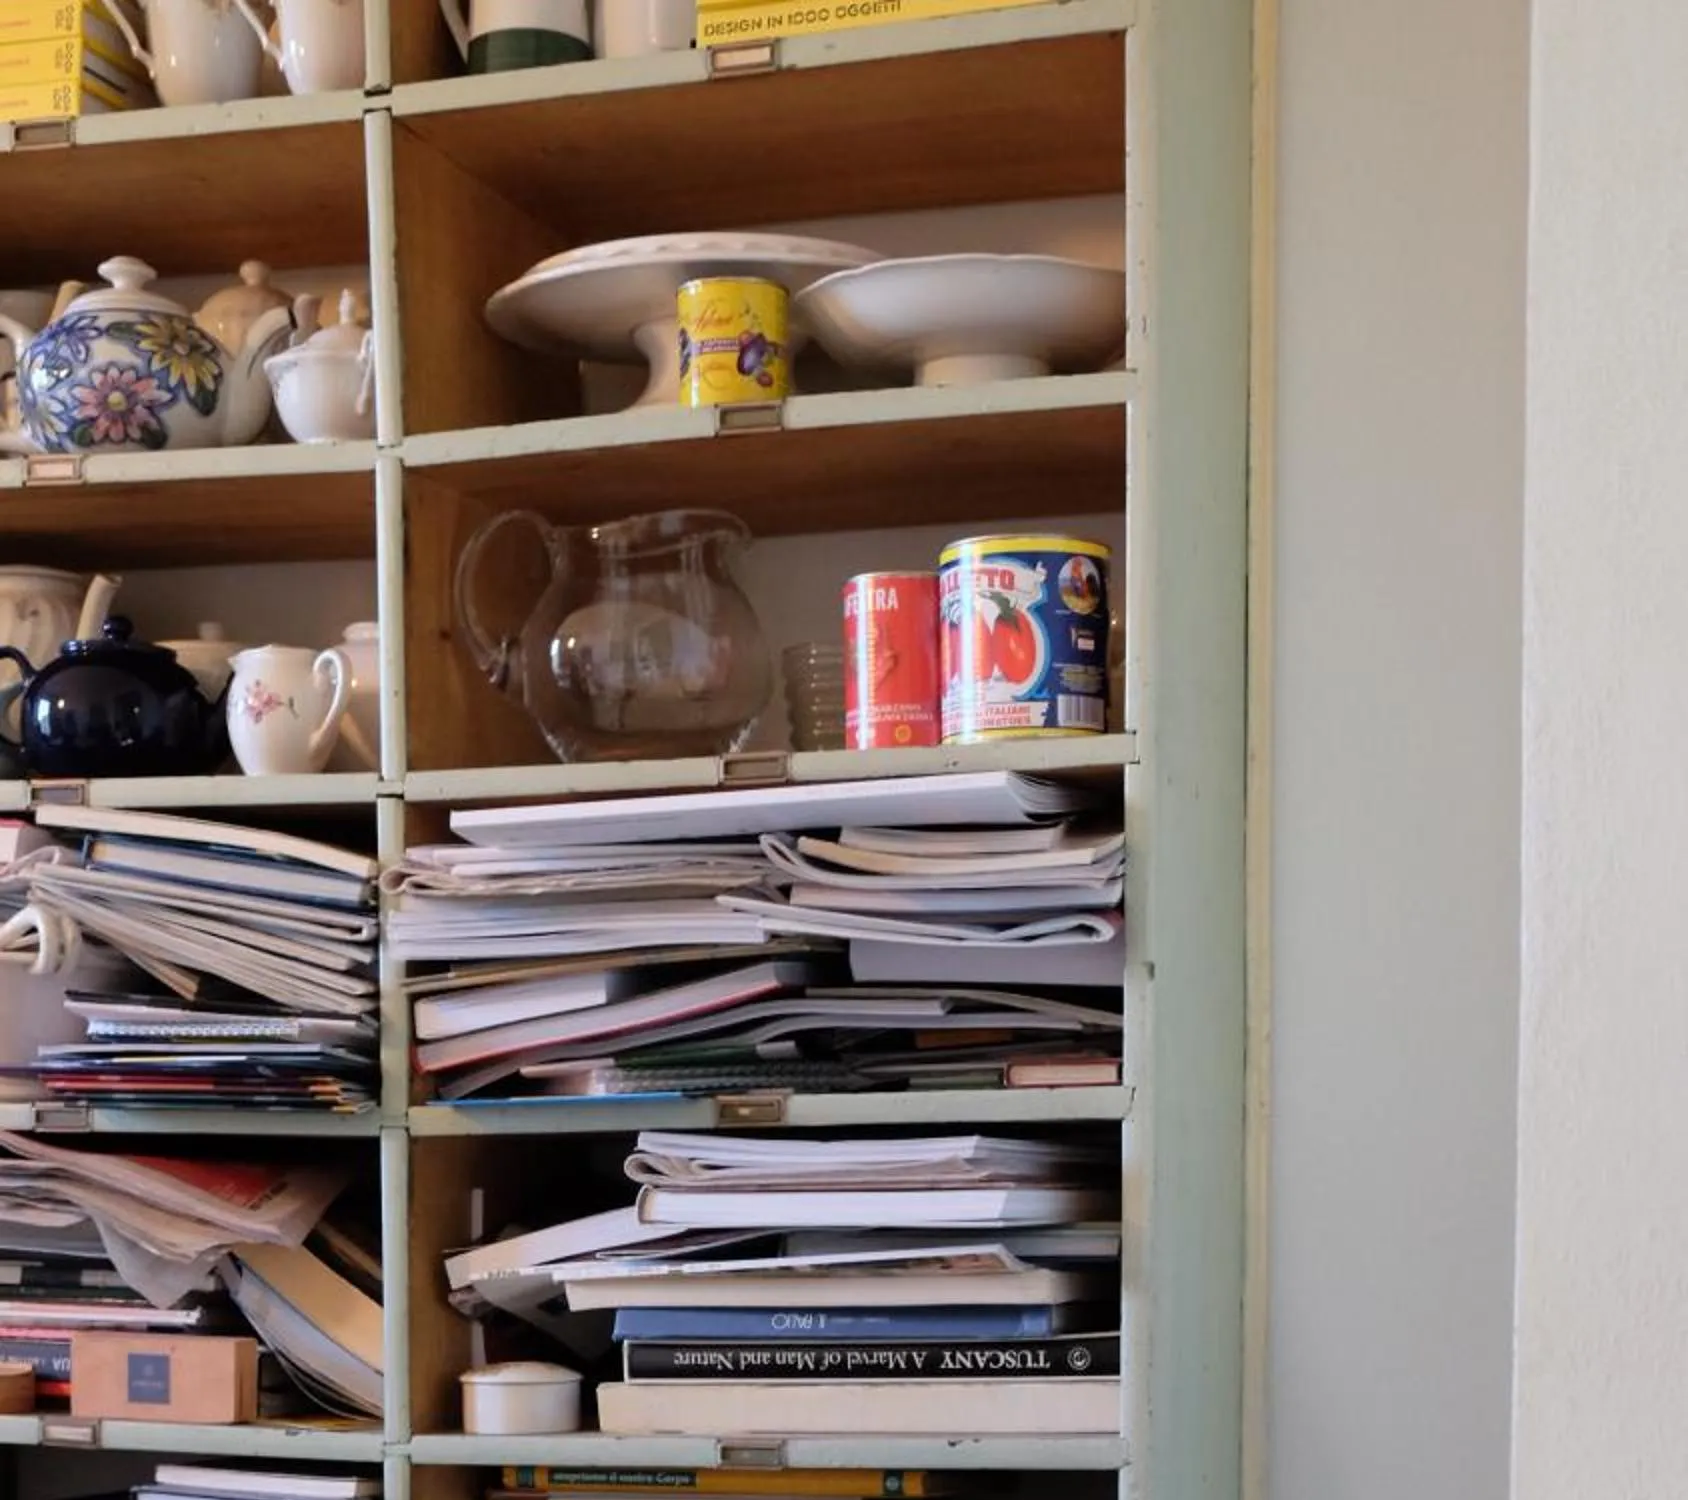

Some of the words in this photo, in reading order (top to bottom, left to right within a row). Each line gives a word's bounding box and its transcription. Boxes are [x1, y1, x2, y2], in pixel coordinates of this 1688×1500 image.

[703, 16, 763, 38] DESIGN
[766, 15, 784, 29] IN
[787, 7, 831, 26] 1000
[771, 1313, 814, 1330] PALIO
[673, 1349, 735, 1370] Nature
[739, 1349, 772, 1371] and
[774, 1349, 817, 1371] Man
[819, 1349, 842, 1371] of
[845, 1349, 909, 1371] Marvel
[911, 1349, 927, 1371] A
[940, 1348, 1051, 1372] TUSCANY
